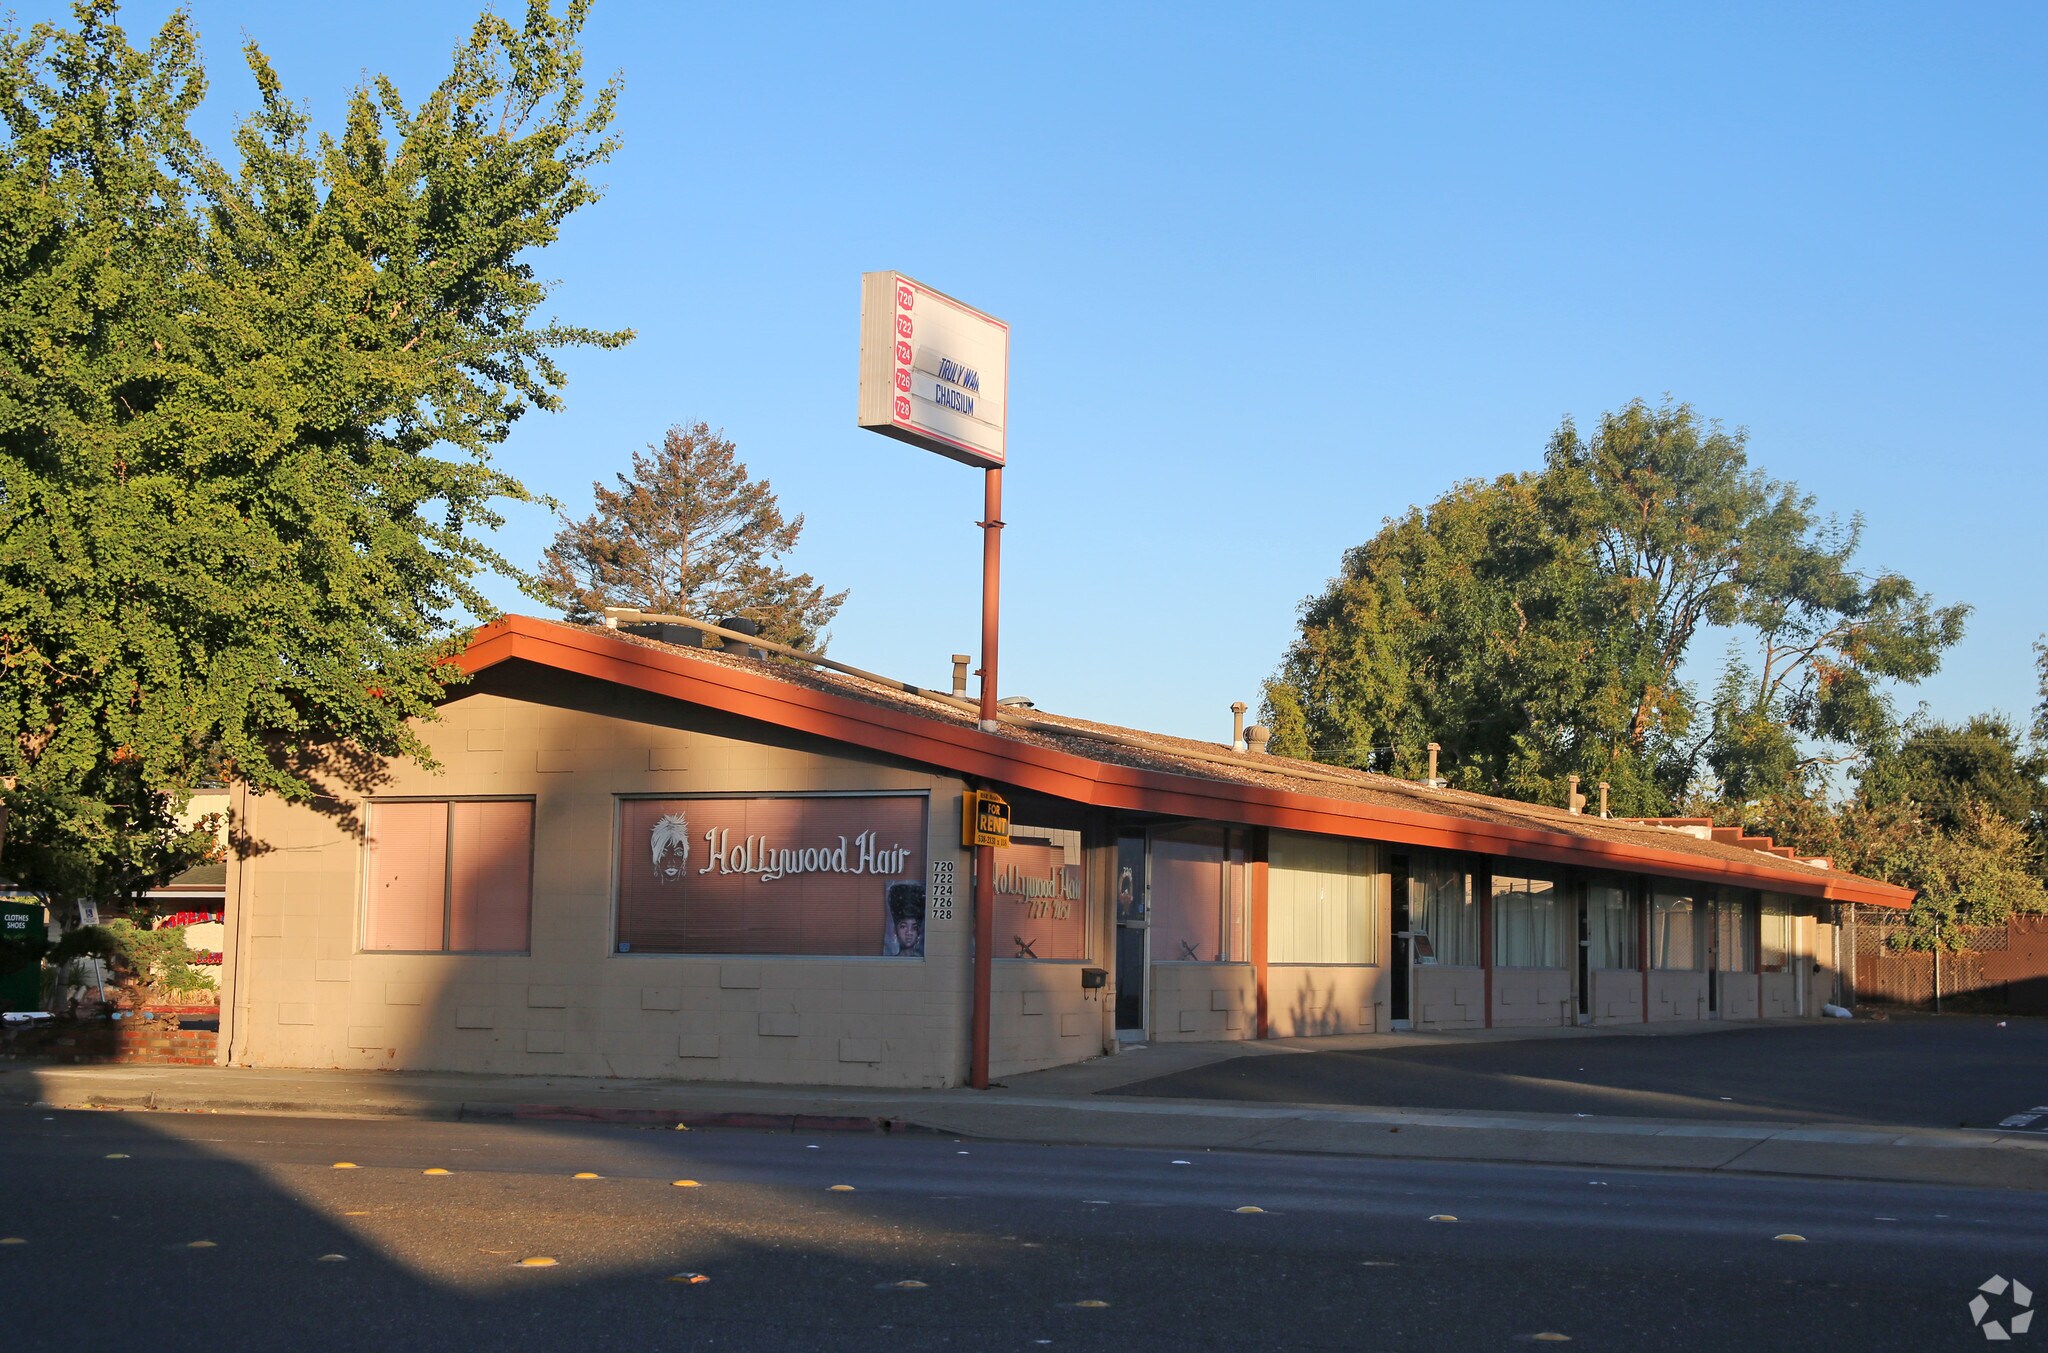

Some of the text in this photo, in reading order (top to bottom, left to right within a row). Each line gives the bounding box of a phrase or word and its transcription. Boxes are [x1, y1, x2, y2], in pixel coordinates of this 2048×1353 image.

[899, 290, 912, 307] 720
[899, 318, 912, 335] 722
[898, 344, 911, 360] 724
[938, 357, 965, 384] TRULY
[896, 372, 910, 388] 726
[935, 383, 974, 416] CHAOSIUM
[896, 400, 910, 415] 728
[987, 803, 1001, 816] FOR
[980, 814, 1007, 833] RENT
[699, 826, 911, 882] Hollywood Hair
[934, 861, 954, 872] 720
[933, 873, 953, 884] 722
[933, 885, 953, 896] 724
[933, 897, 952, 908] 726
[4, 914, 29, 922] CLOTHES
[932, 909, 952, 920] 728
